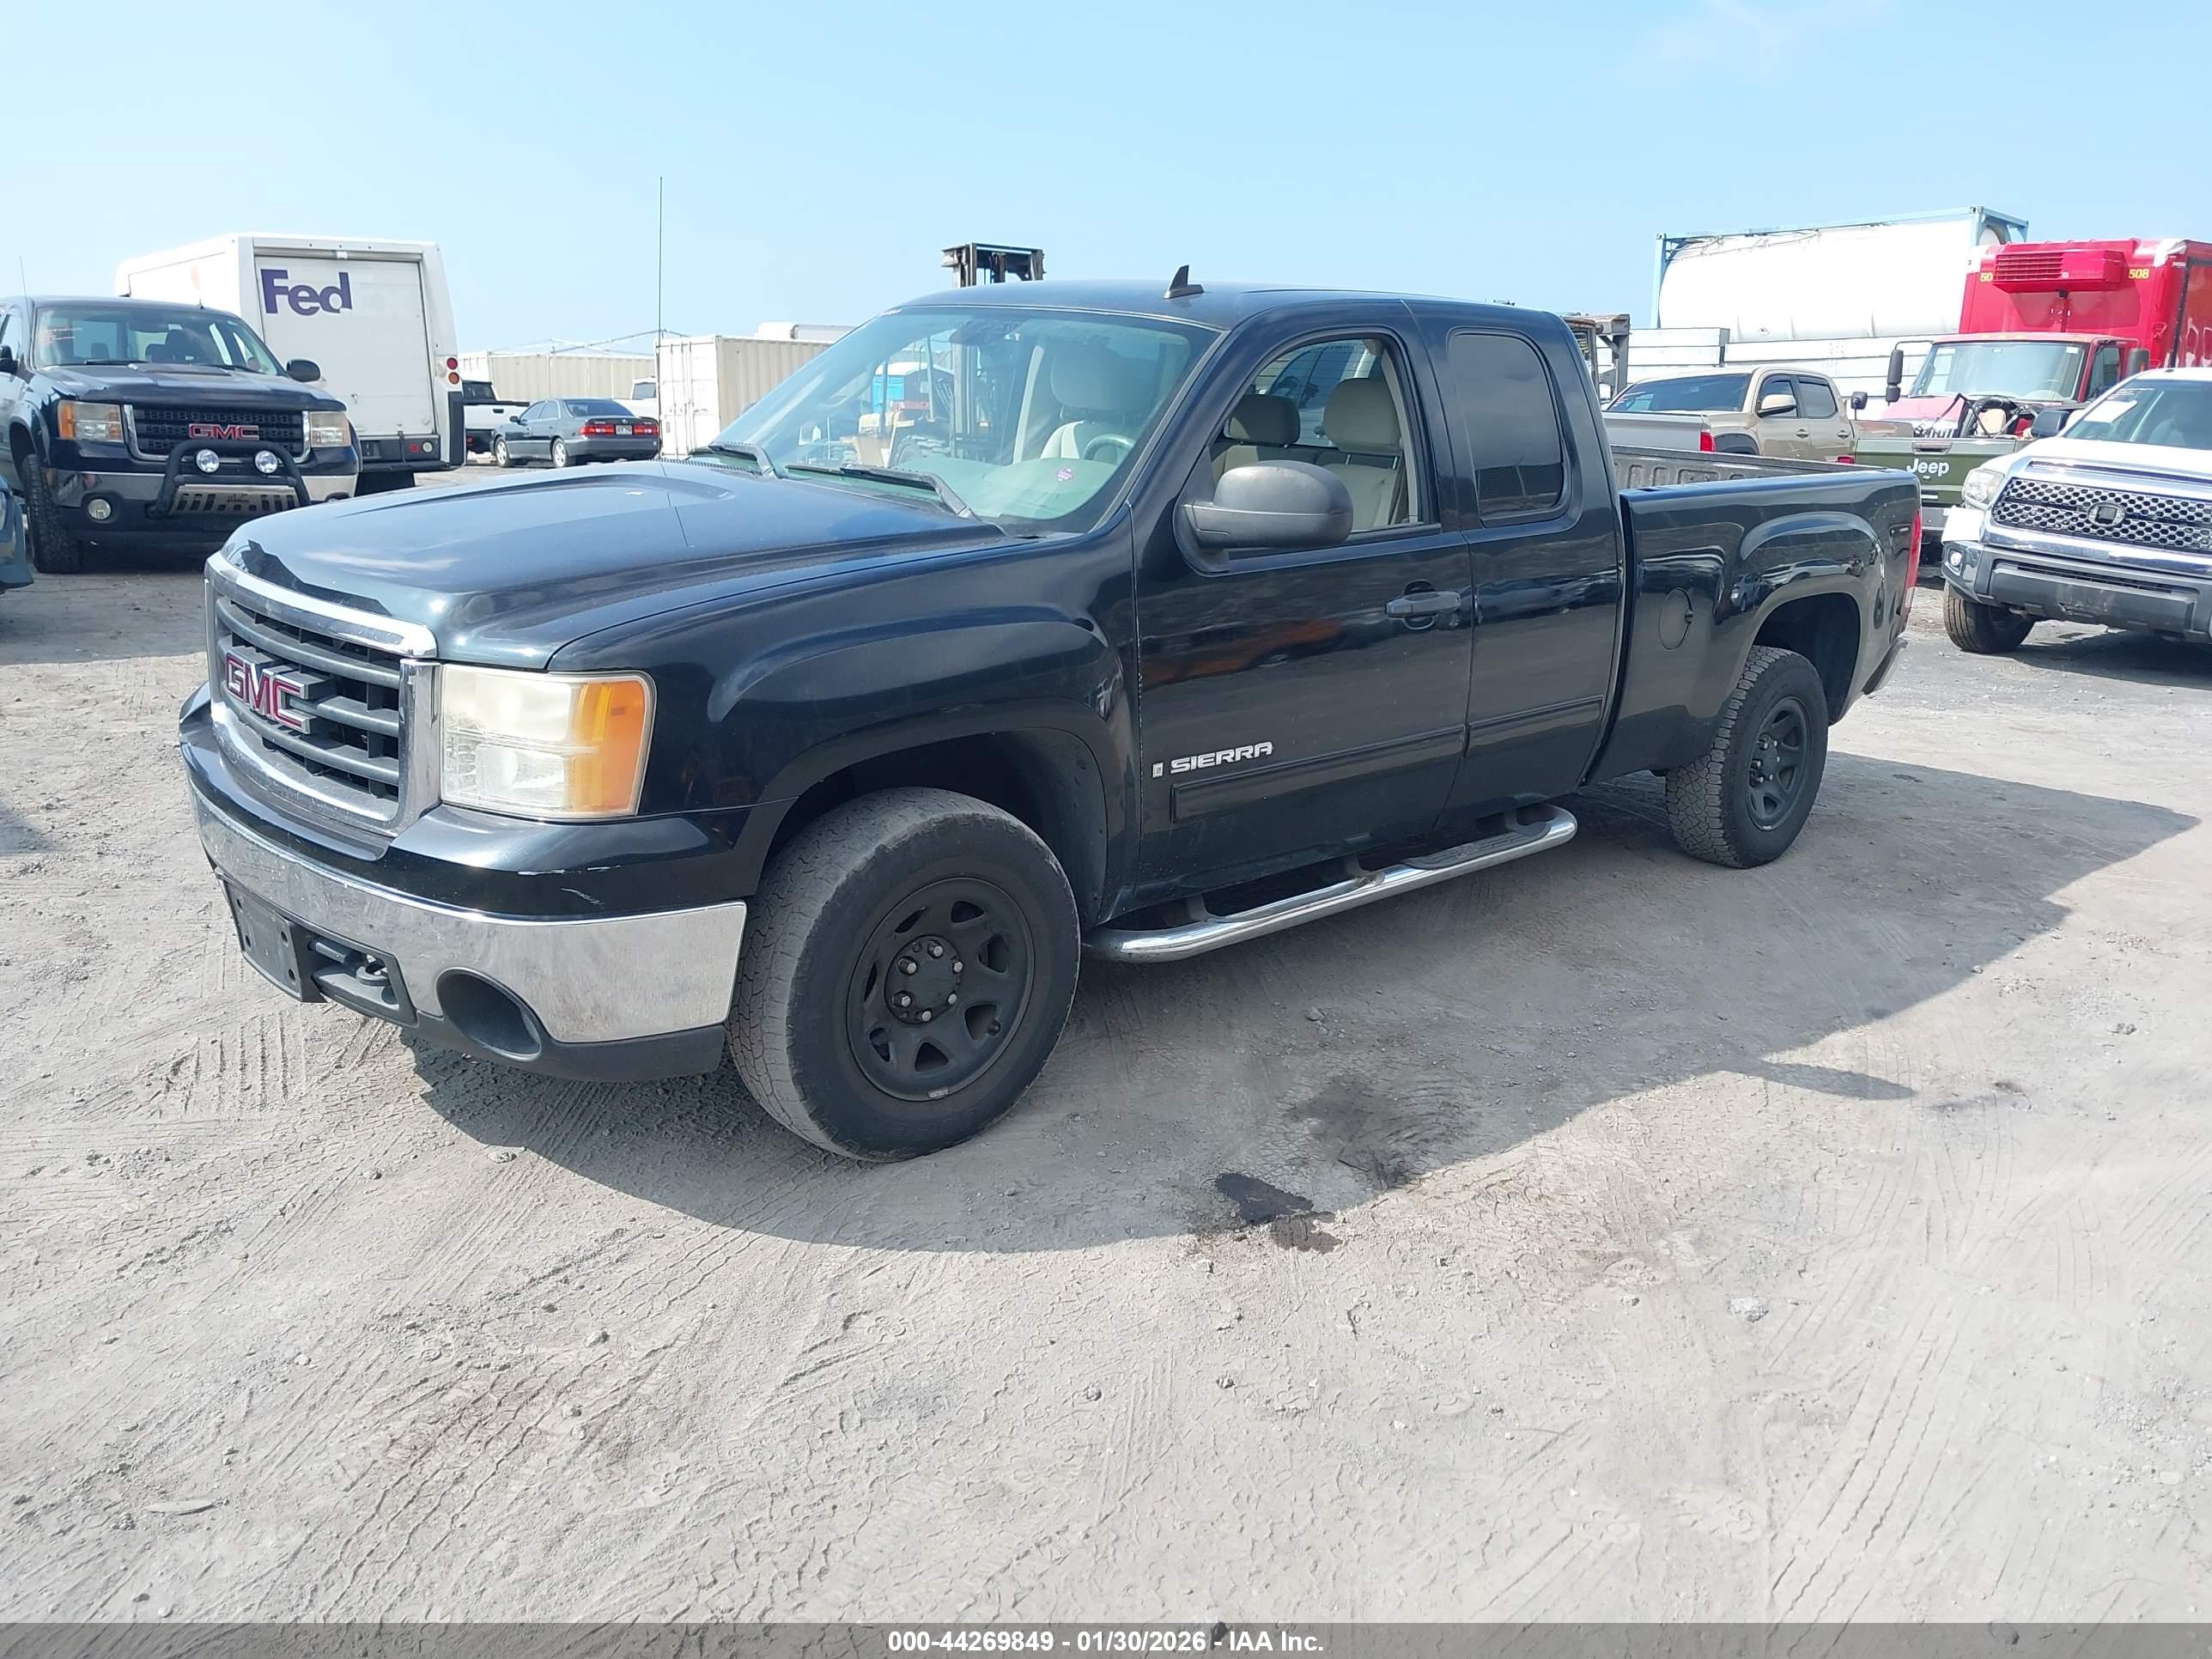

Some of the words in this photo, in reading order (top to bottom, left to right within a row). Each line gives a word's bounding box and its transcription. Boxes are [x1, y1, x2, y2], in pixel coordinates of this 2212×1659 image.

[1979, 272, 1993, 283] 50
[2129, 269, 2149, 279] 508
[260, 269, 352, 316] Fed
[189, 423, 259, 440] GMC
[1906, 458, 1950, 477] Jeep
[225, 650, 311, 734] GMC
[1170, 741, 1273, 774] SIERRA
